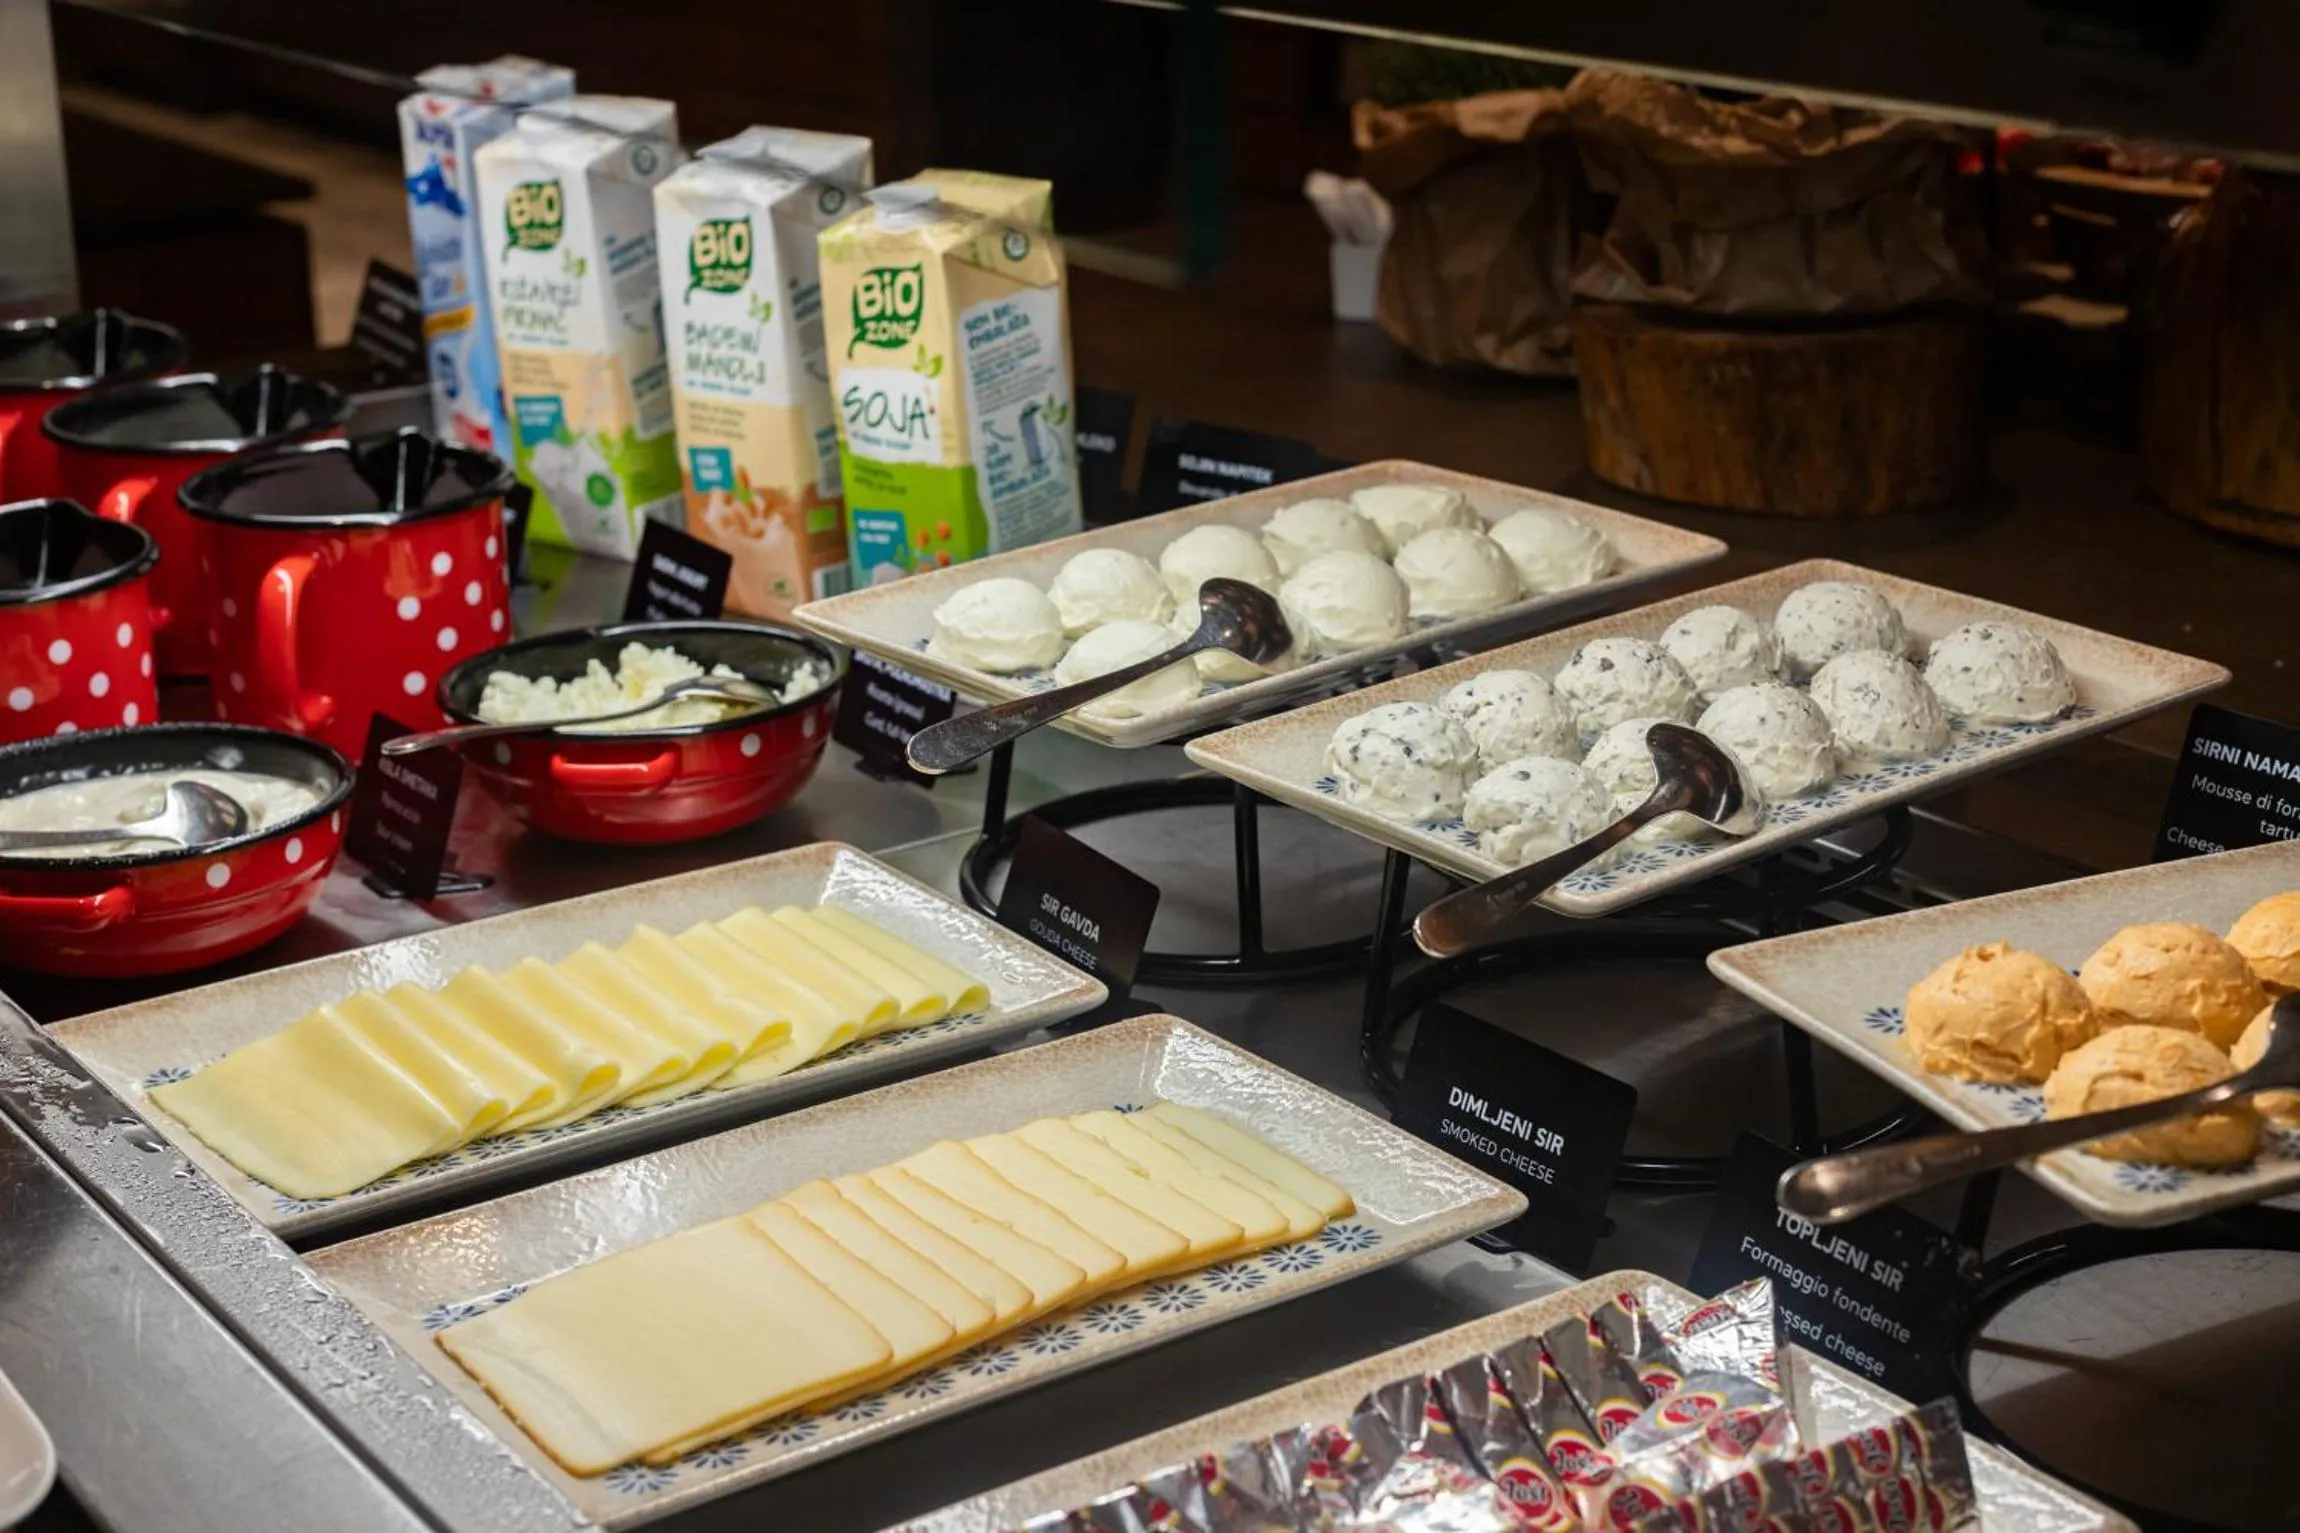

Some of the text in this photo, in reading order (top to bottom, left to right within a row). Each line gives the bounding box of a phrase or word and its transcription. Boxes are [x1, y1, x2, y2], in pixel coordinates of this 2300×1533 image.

[693, 222, 751, 268] BiO
[856, 271, 920, 318] BiO
[863, 320, 917, 341] ZONE
[843, 386, 929, 440] SOJA
[2192, 736, 2241, 766] SIRNI
[2191, 773, 2252, 805] Mousse
[2256, 793, 2273, 811] di
[2166, 826, 2225, 854] Cheese
[1040, 892, 1100, 943] SIR GAVDA
[1029, 918, 1098, 970] GOUDA CHEESE
[1449, 1086, 1565, 1157] DIMLJENI SIR
[1440, 1118, 1556, 1185] SMOKED CHEESE
[1776, 1206, 1904, 1293] TOPLJENI SIR
[1740, 1235, 1912, 1344] Formaggio fondente
[1780, 1306, 1823, 1341] ssed
[1825, 1332, 1886, 1378] cheese
